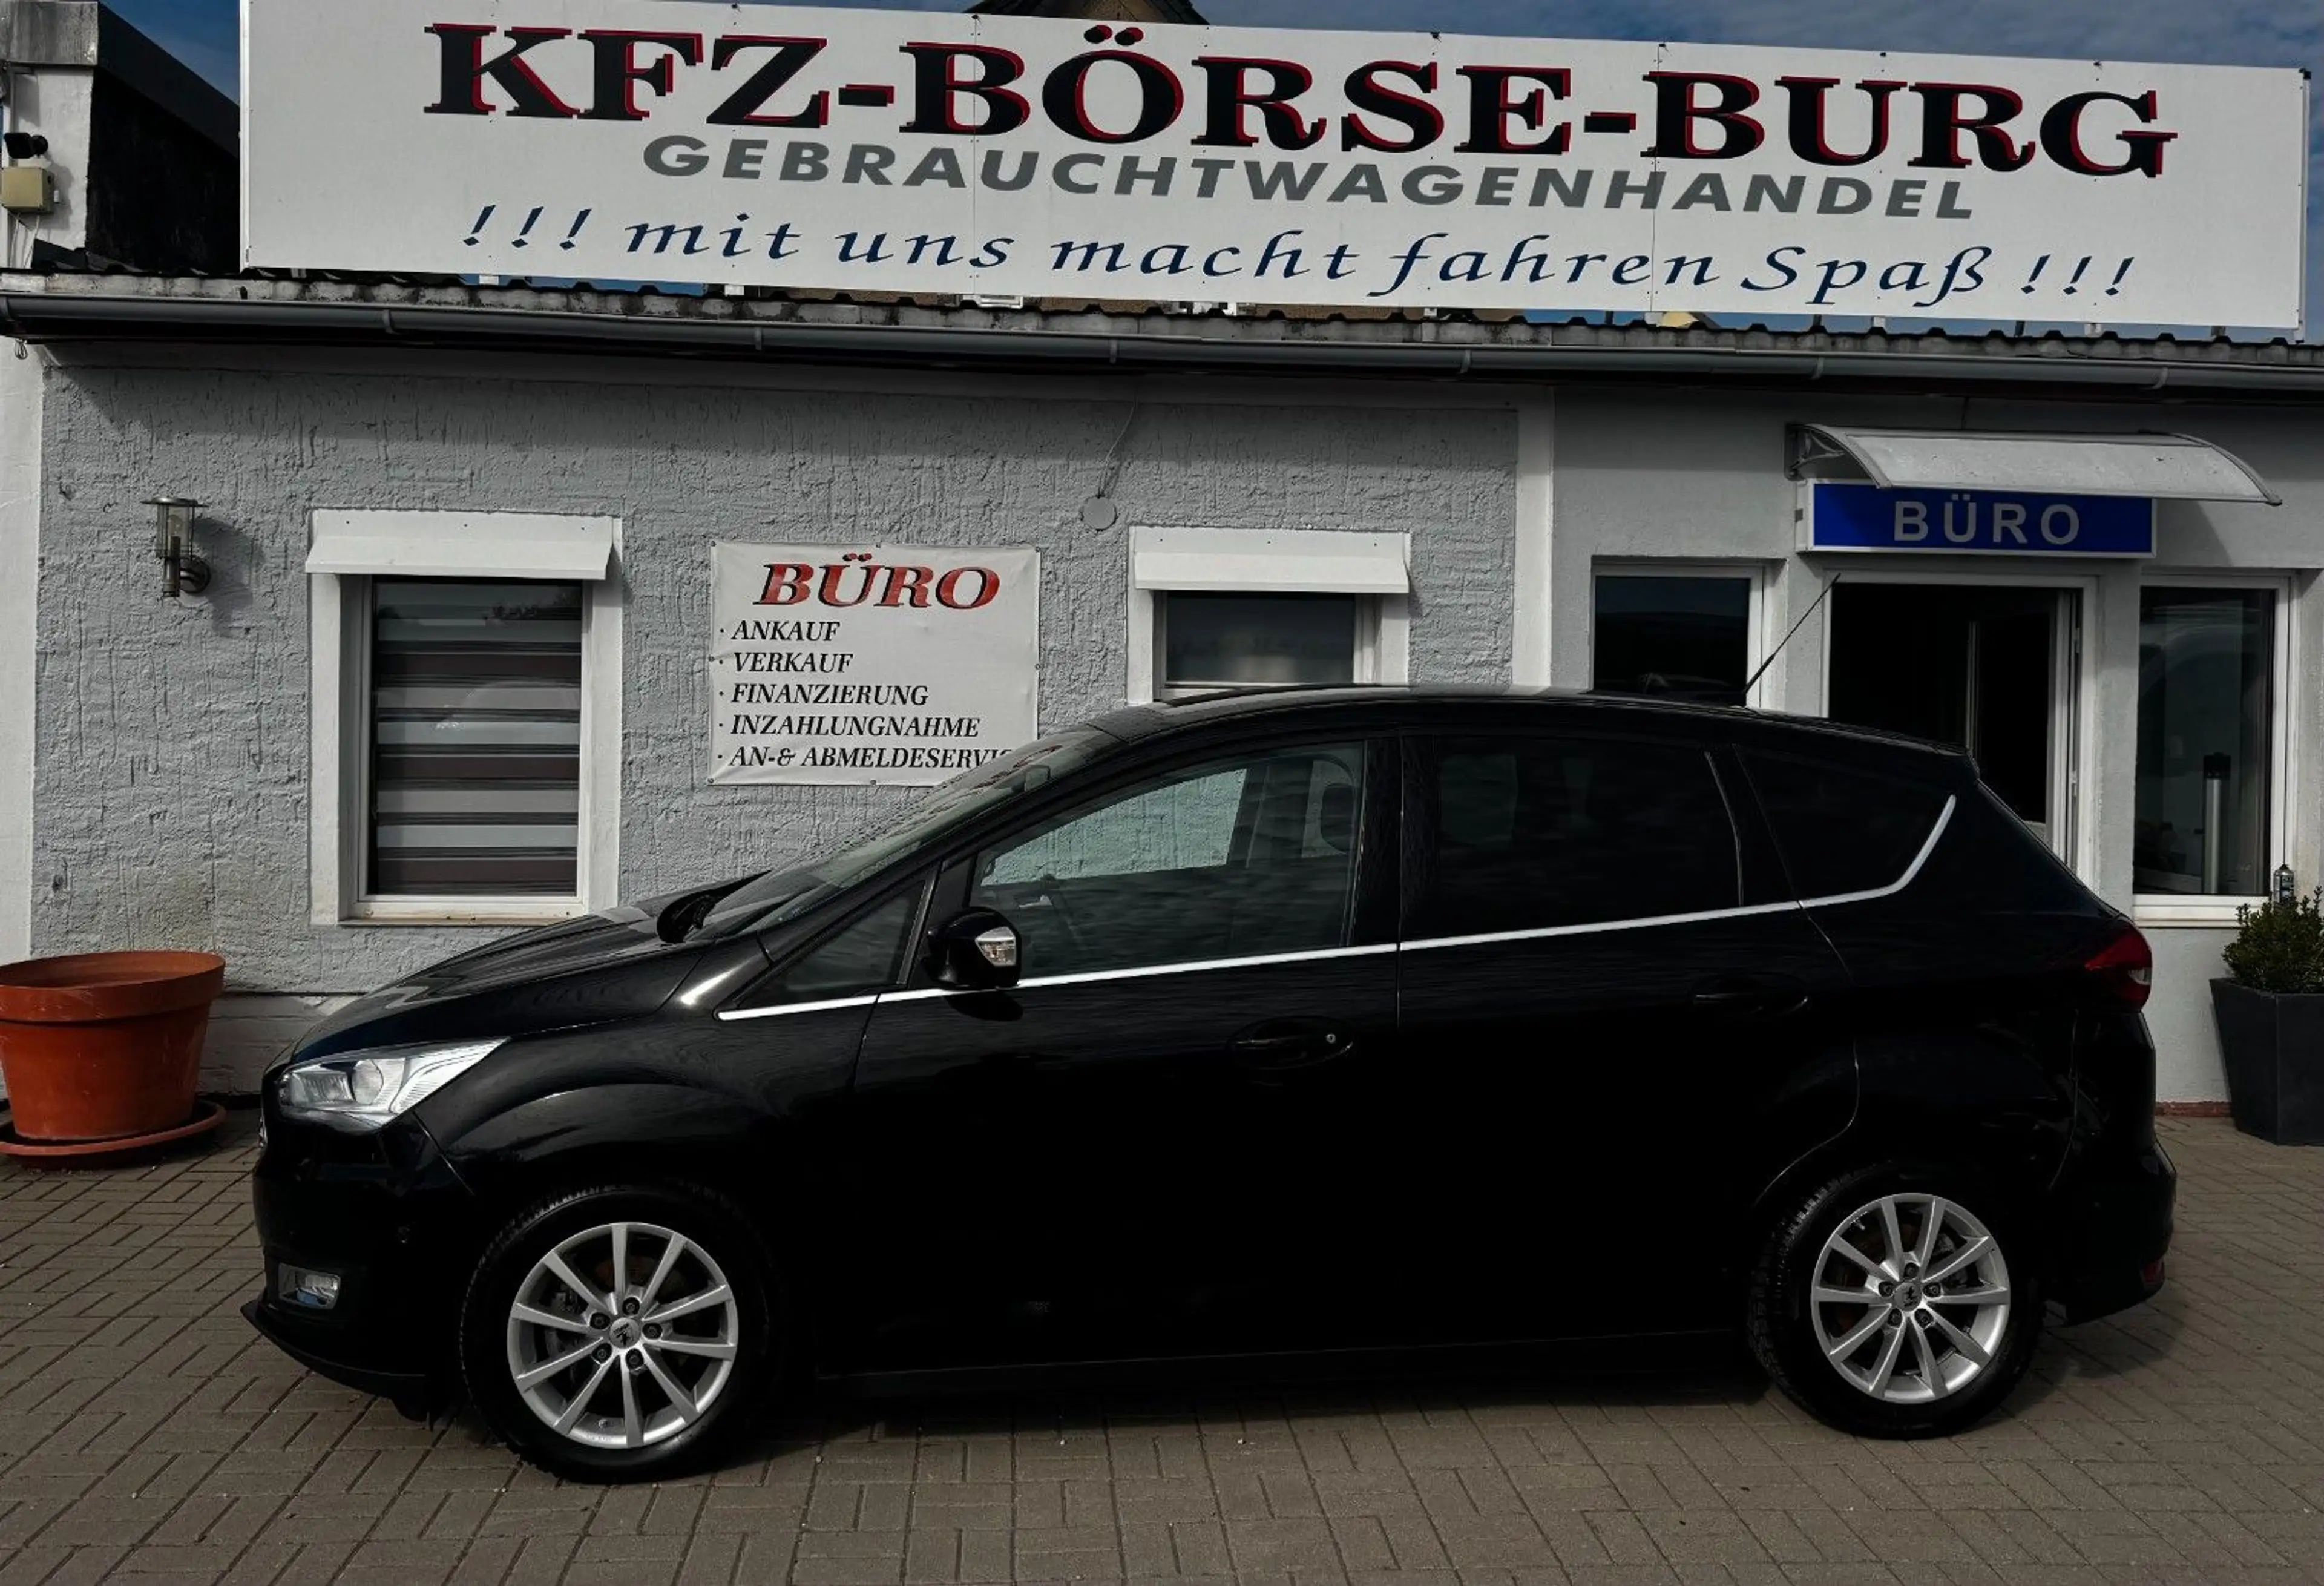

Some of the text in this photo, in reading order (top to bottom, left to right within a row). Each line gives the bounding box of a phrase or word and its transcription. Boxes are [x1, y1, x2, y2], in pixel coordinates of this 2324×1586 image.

[422, 22, 2179, 179] KFZ-BÖRSE-BURG
[643, 134, 1974, 220] GEBRAUCHTWAGENHANDEL
[624, 212, 801, 260] mit
[834, 231, 1016, 268] uns
[1049, 229, 1361, 280] macht
[1366, 232, 1721, 298] fahren
[1739, 246, 1993, 308] Spaß
[1894, 494, 2080, 545] BÜRO
[752, 553, 1000, 610] BÜRO
[730, 620, 841, 642] ANKAUF
[733, 652, 853, 673] VERKAUF
[730, 683, 929, 705] FINANZIERUNG
[729, 715, 980, 737] INZAHLUNGNAHME
[802, 747, 1012, 768] ABMELDESERV
